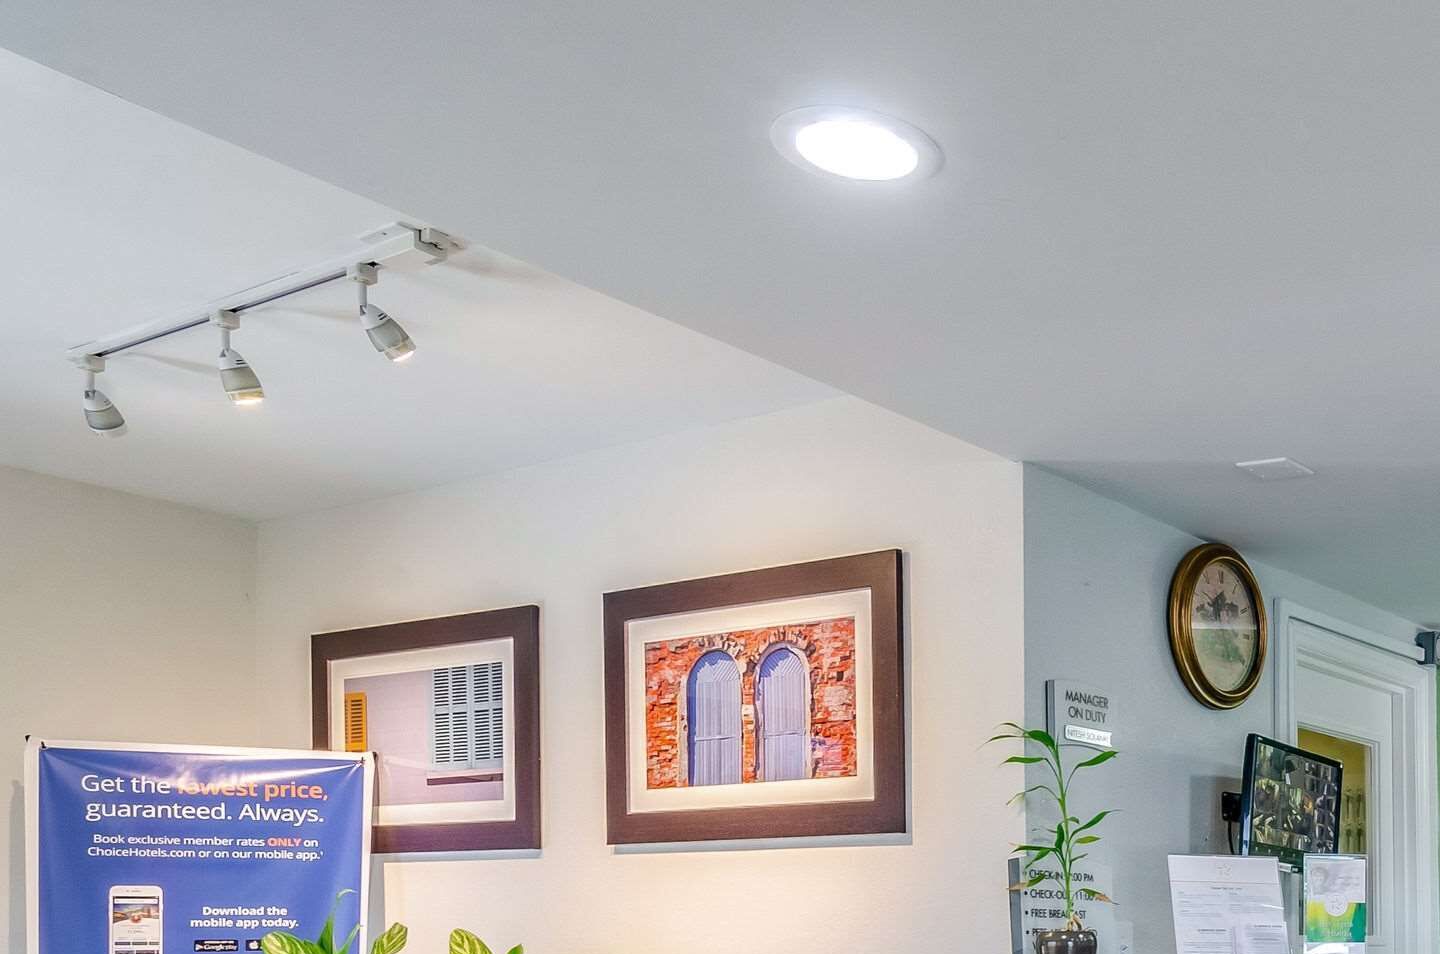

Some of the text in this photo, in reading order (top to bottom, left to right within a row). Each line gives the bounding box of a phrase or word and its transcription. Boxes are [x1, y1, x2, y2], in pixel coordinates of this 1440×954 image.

[1065, 690, 1109, 709] MANAGER
[1068, 706, 1106, 723] ON DUTY
[81, 774, 125, 794] Get
[130, 775, 171, 795] the
[264, 781, 329, 801] price,
[85, 801, 324, 826] guaranteed. Always.
[93, 834, 319, 848] Book exclusive member rates ONLY on
[87, 847, 196, 858] ChoiceHotels.com
[198, 850, 210, 858] or
[213, 850, 230, 858] on
[232, 851, 252, 859] our
[254, 849, 294, 860] mobile
[1083, 873, 1094, 881] PM
[202, 906, 288, 916] Download the
[1030, 908, 1047, 918] FREE
[190, 918, 299, 929] mobile app today.
